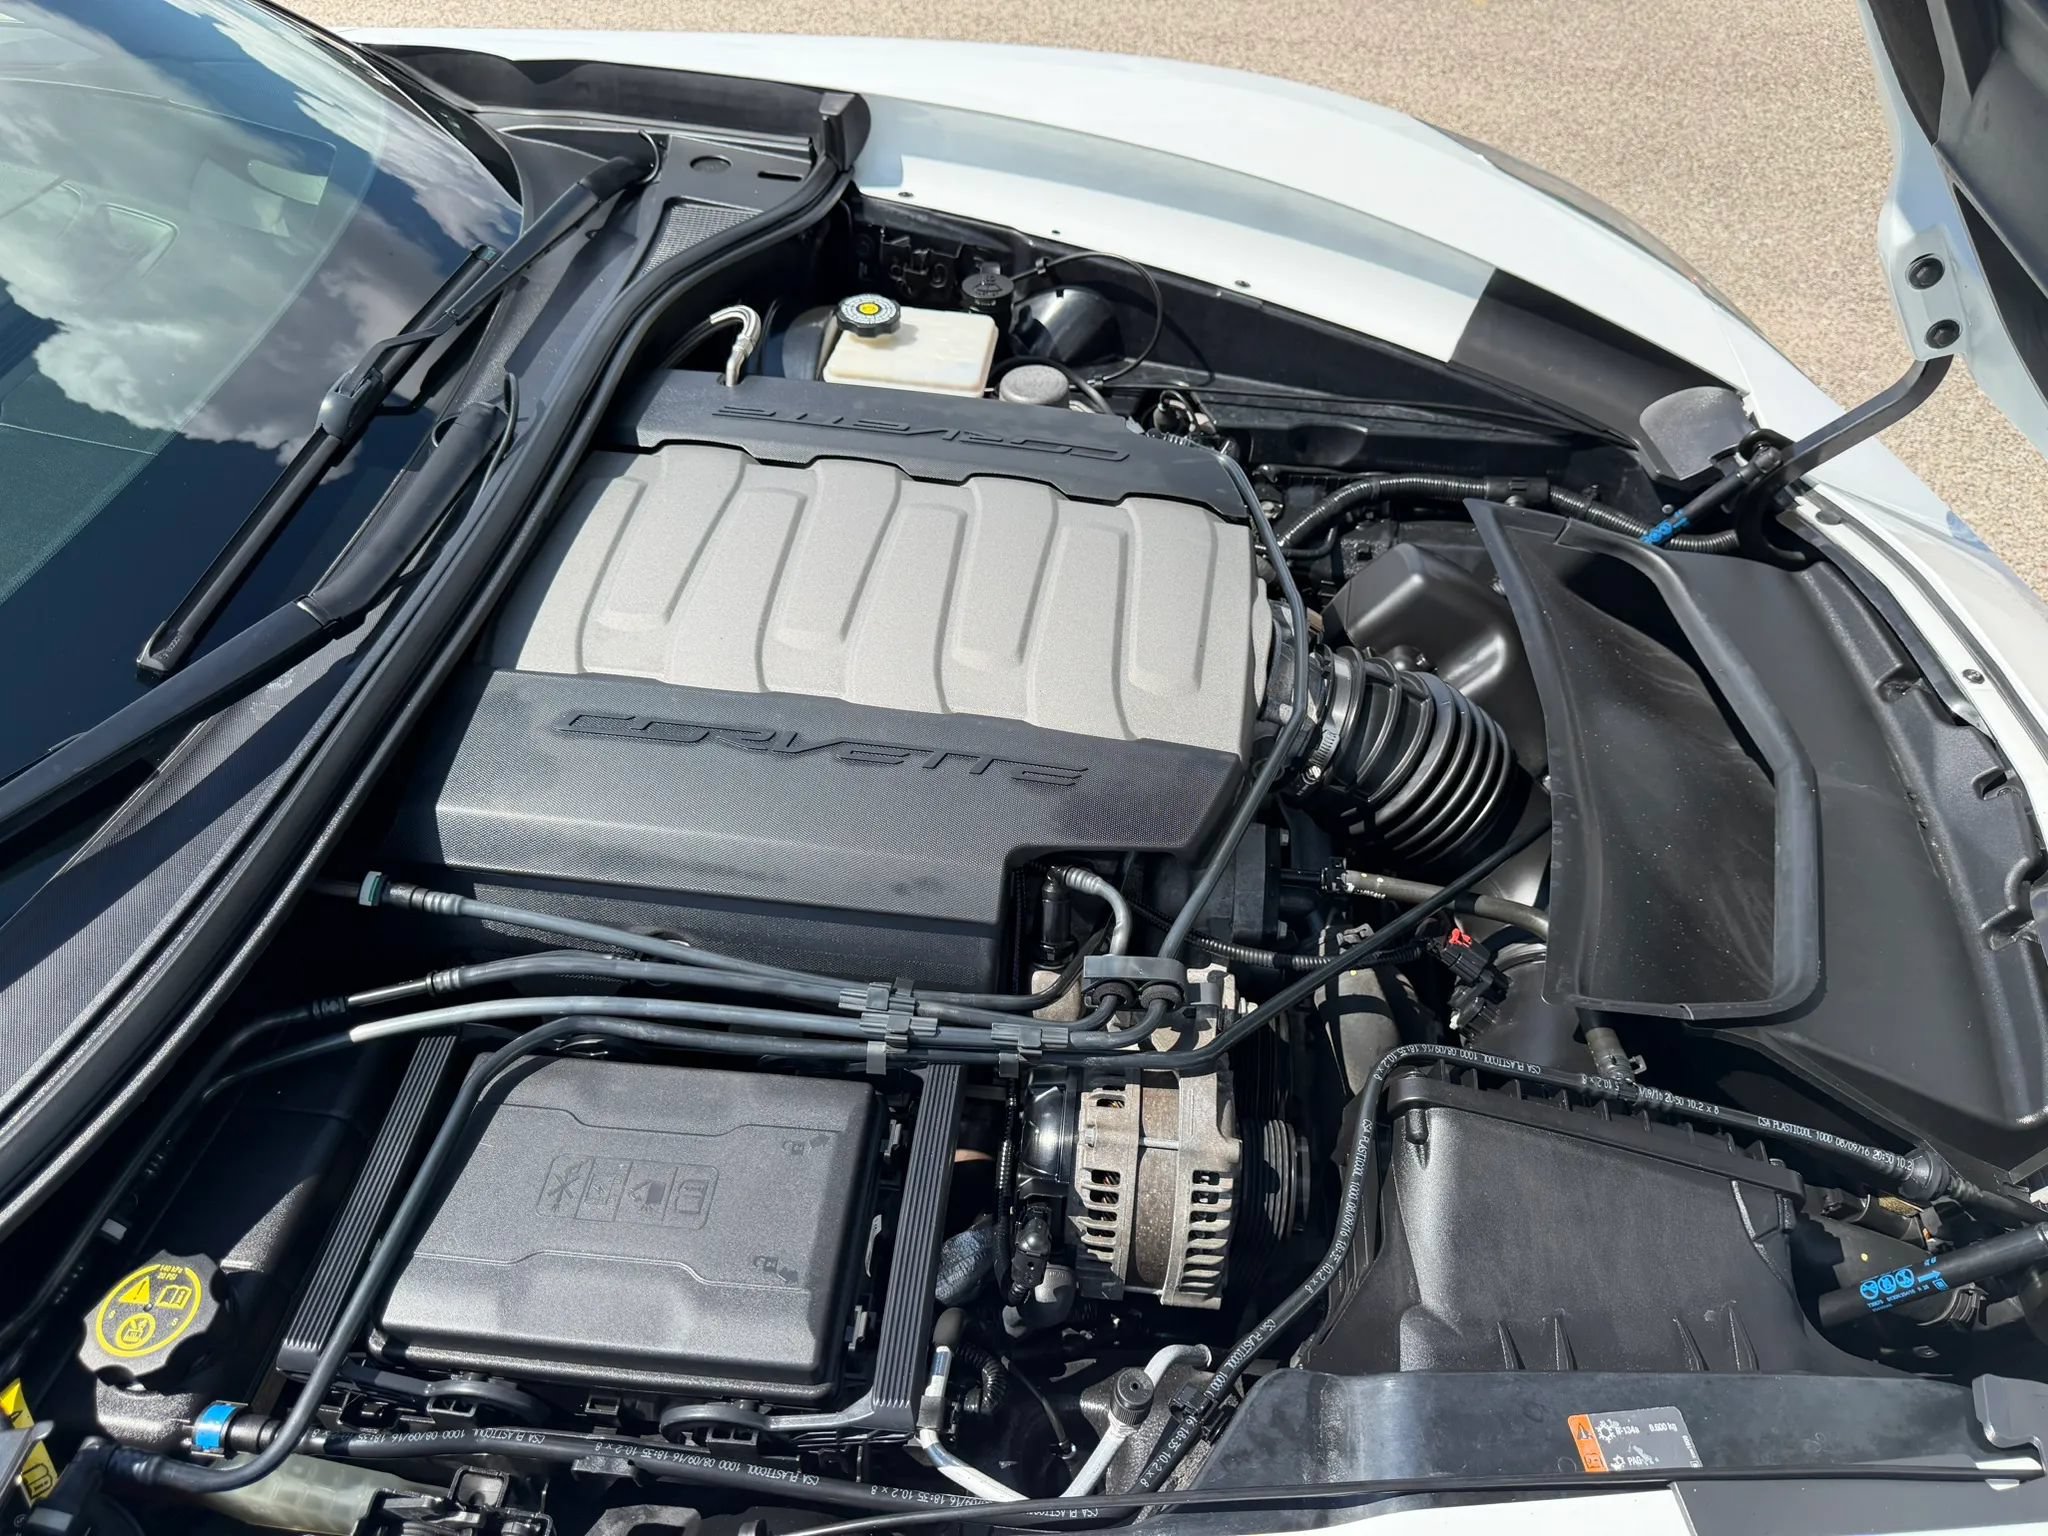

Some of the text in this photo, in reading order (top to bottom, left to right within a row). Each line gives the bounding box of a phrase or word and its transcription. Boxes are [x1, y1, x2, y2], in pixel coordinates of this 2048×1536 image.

[712, 405, 1131, 462] CORVETTE
[556, 710, 1090, 787] CORVETTE
[1460, 1049, 1478, 1061] 1000
[1480, 1054, 1525, 1072] PLASTICOOL
[1686, 1099, 1704, 1112] 10.2
[1757, 1116, 1914, 1171] CSA PLASTICOOL 1000 08/09/16 20:50 10.2
[1352, 1135, 1371, 1177] PLASTICOOL
[1348, 1181, 1361, 1200] 1000
[1339, 1201, 1357, 1238] 08/09/16
[1315, 1262, 1334, 1281] 10.2
[1223, 1332, 1263, 1371] PLASTICOOL
[391, 1429, 439, 1442] 08/09/16
[441, 1428, 465, 1440] 1000
[1167, 1427, 1190, 1452] 18:35
[595, 1441, 603, 1451] 8
[615, 1443, 638, 1456] 10.2
[640, 1447, 669, 1461] 18:35
[672, 1453, 716, 1468] 08/09/16
[718, 1460, 741, 1472] 1000
[1152, 1452, 1171, 1472] 10.2
[746, 1463, 799, 1483] PLASTICOOL
[802, 1474, 820, 1485] CSA
[871, 1484, 878, 1495] 8
[1140, 1478, 1150, 1488] 8
[891, 1486, 914, 1500] 10.2
[917, 1491, 945, 1505] 18:35
